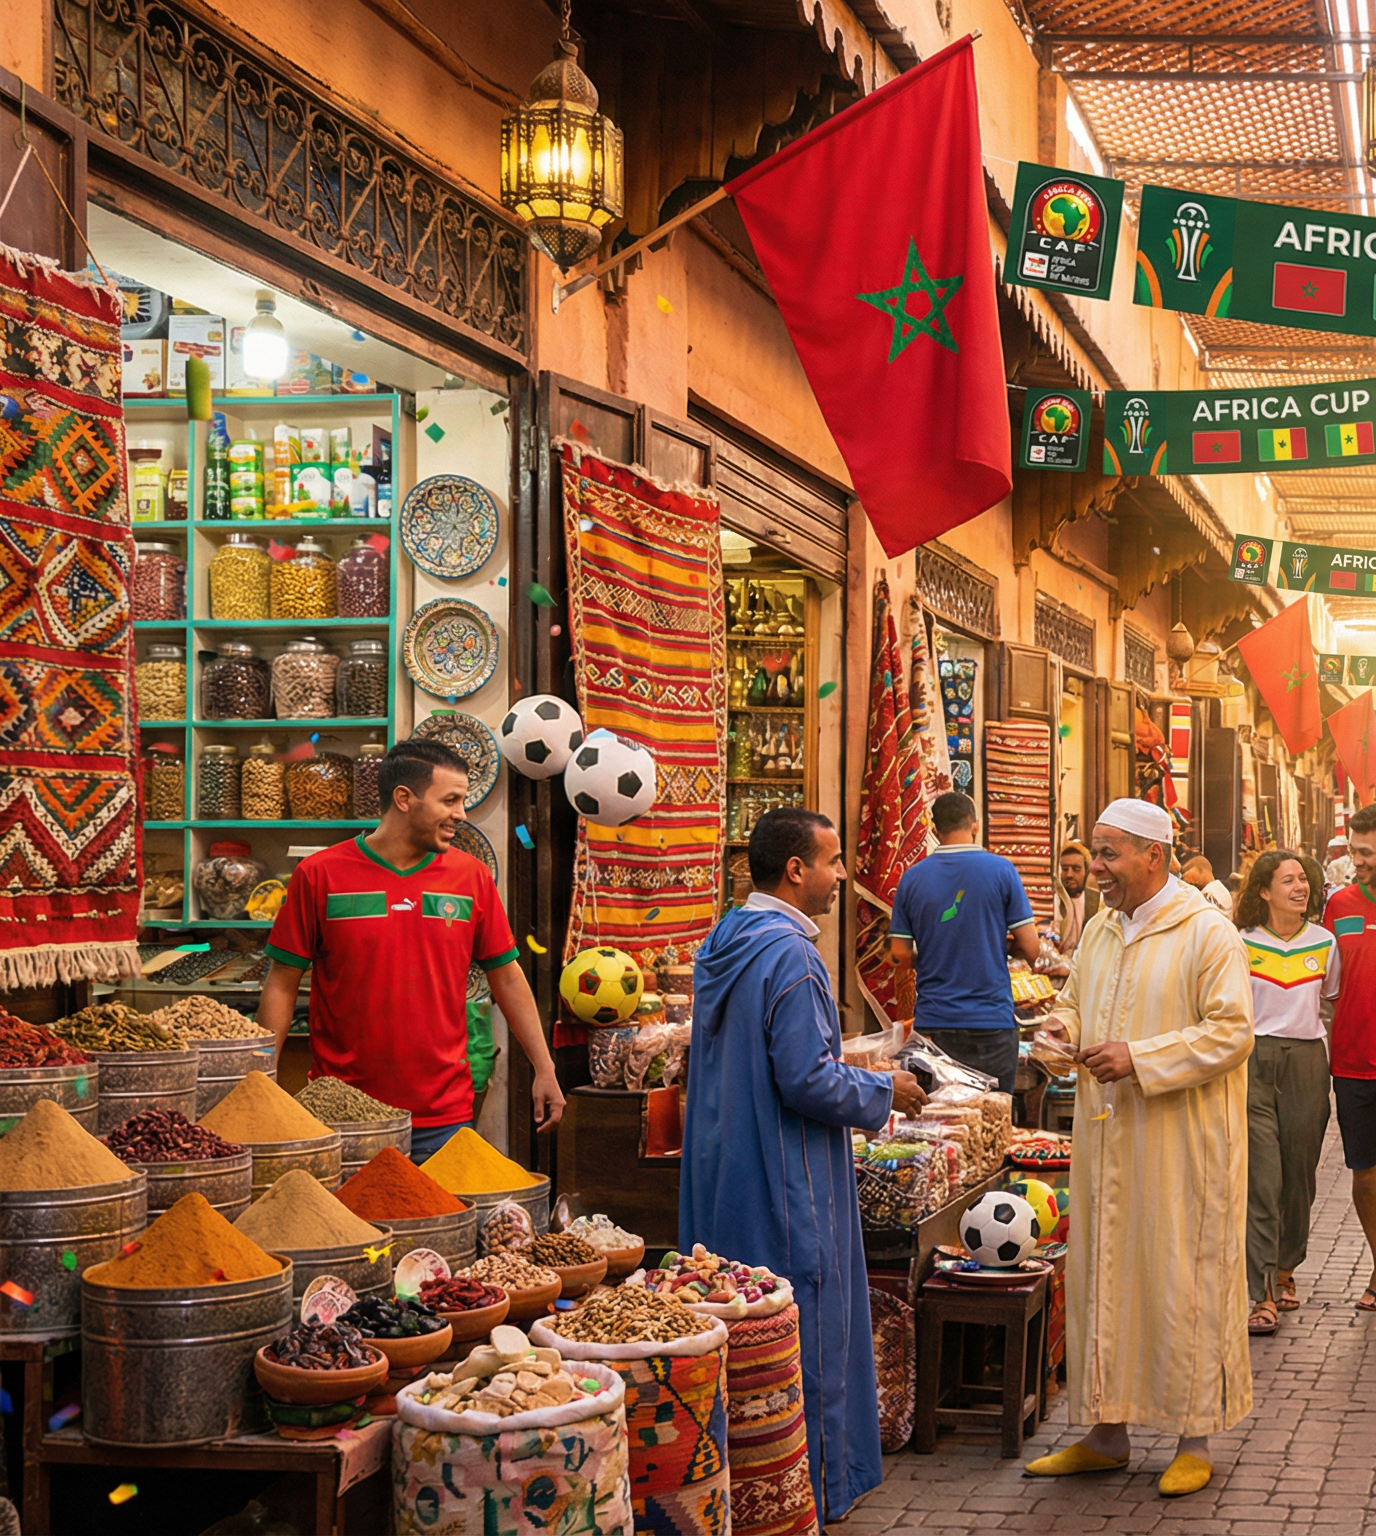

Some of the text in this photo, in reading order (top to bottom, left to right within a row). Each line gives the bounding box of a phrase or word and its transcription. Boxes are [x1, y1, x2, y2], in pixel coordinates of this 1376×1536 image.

[1039, 237, 1086, 254] CAF
[1192, 397, 1302, 422] AFRICA
[1310, 391, 1370, 416] CUP
